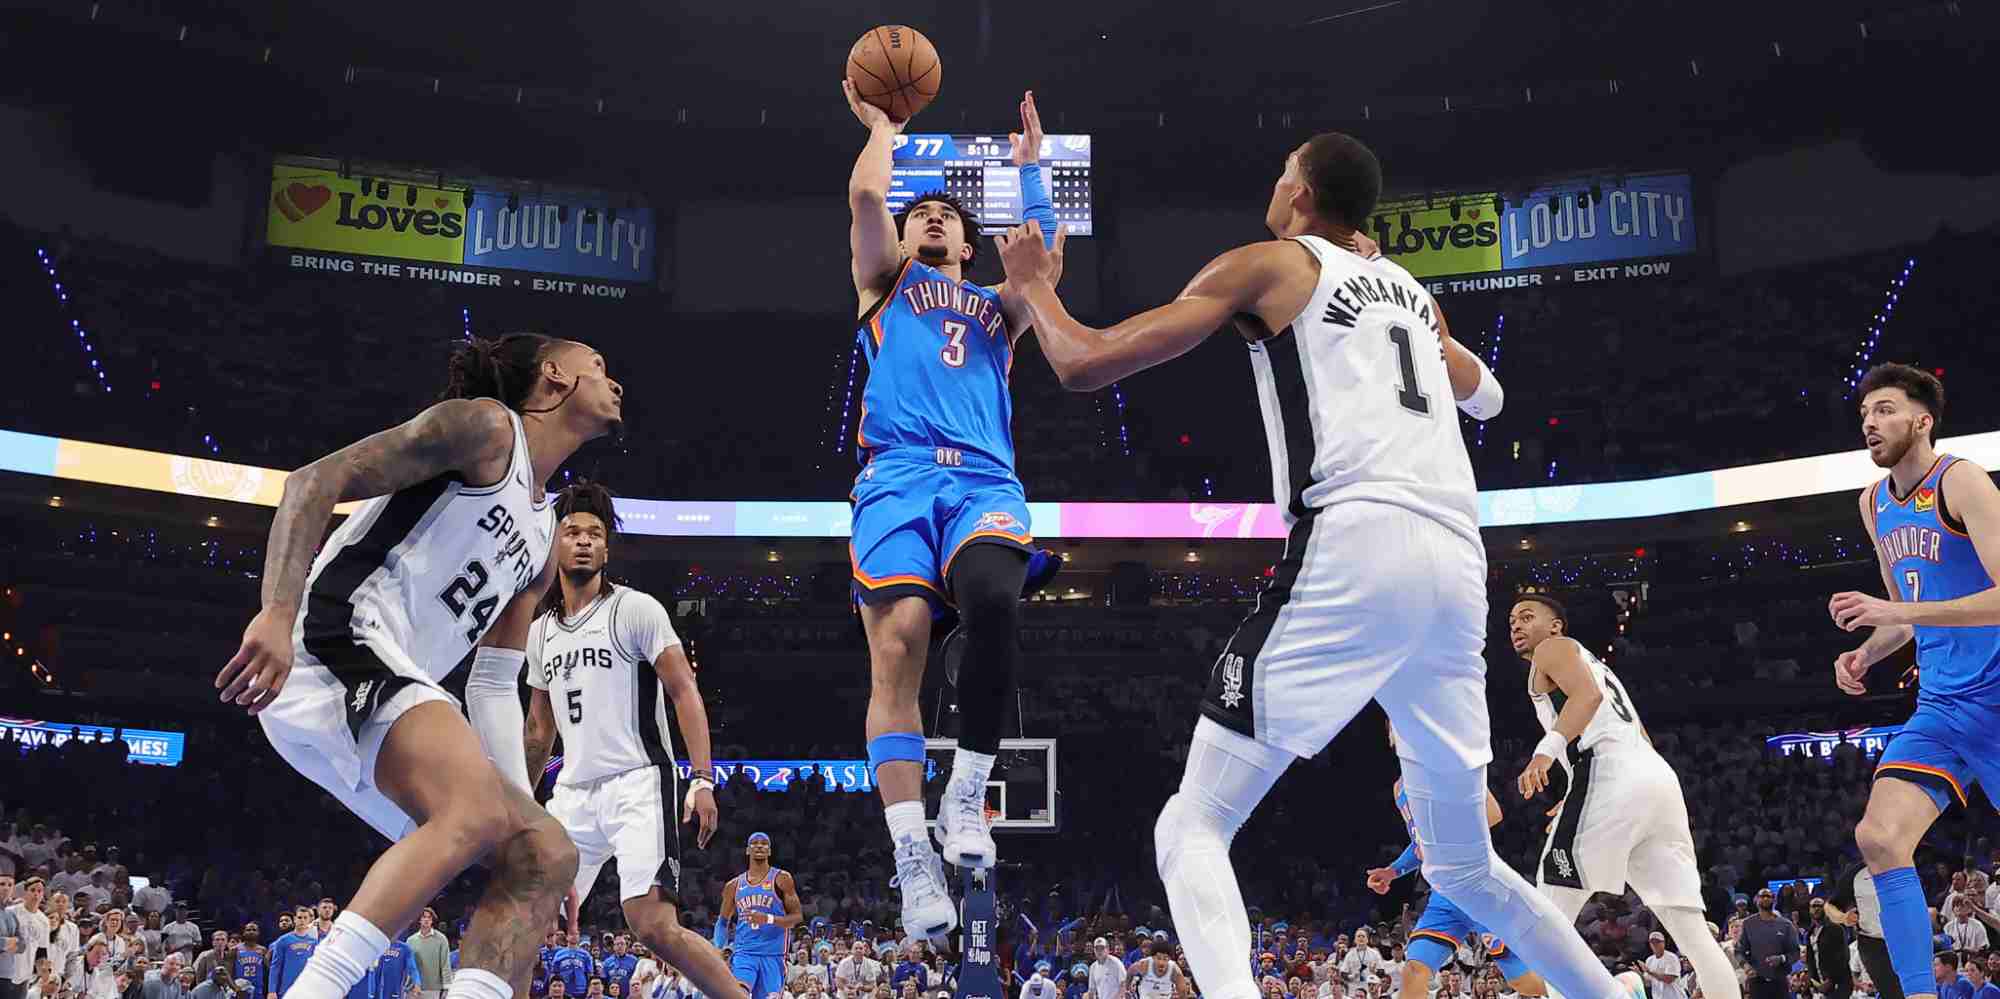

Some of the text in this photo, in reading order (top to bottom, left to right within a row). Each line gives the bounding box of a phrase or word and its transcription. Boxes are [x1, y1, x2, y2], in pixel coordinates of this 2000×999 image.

[914, 138, 944, 156] 77
[474, 204, 647, 272] LOUD CITY
[1508, 190, 1684, 259] LOUD CITY
[291, 255, 627, 299] BRING THE THUNDER EXIT NOW
[1425, 262, 1671, 295] HE THUNDER EXIT NOW
[902, 280, 1003, 338] THUNDER
[1321, 275, 1442, 350] WEMBANYA
[941, 318, 966, 368] 3
[1387, 322, 1433, 418] 1
[936, 448, 961, 466] OKC
[1880, 525, 1942, 568] THUNDER
[435, 560, 500, 645] 24
[543, 647, 612, 684] SPURS
[567, 689, 582, 724] 5
[971, 920, 987, 934] GET
[972, 934, 987, 947] THE
